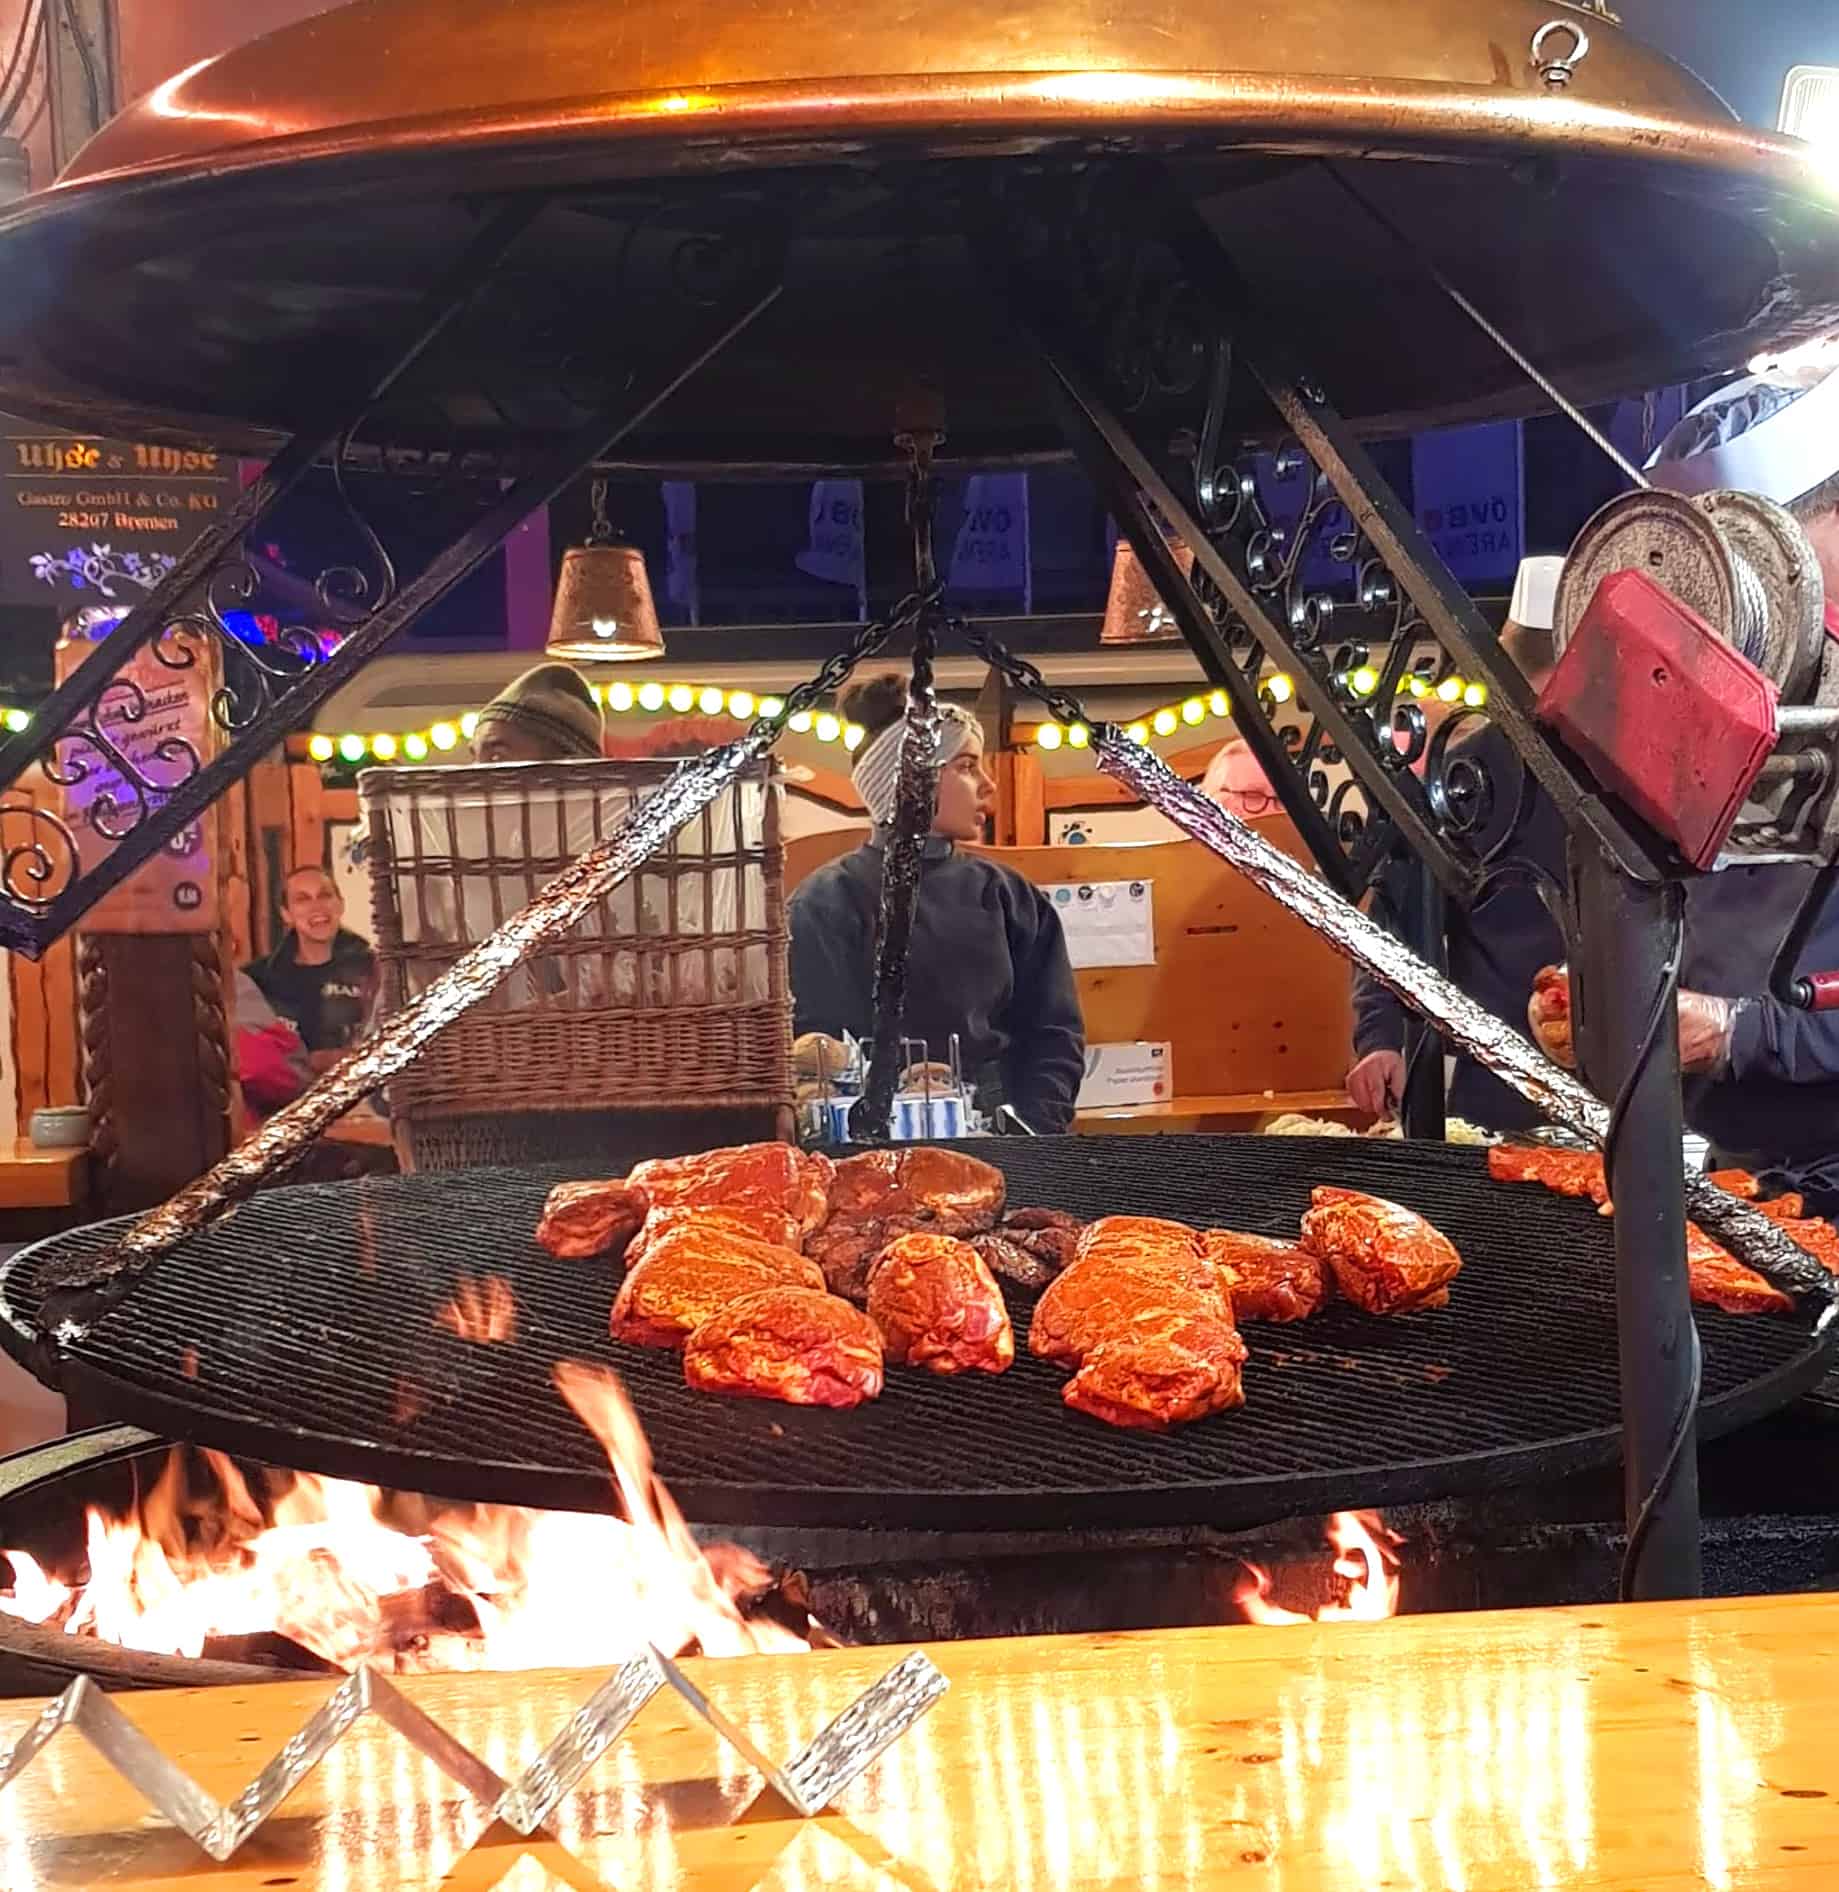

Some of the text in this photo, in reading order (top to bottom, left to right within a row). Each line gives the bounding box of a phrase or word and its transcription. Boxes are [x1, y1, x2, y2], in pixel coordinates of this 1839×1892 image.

[106, 454, 125, 468] &
[76, 490, 130, 506] GmbH
[136, 493, 152, 507] &
[57, 511, 179, 531] 28207 Bremen
